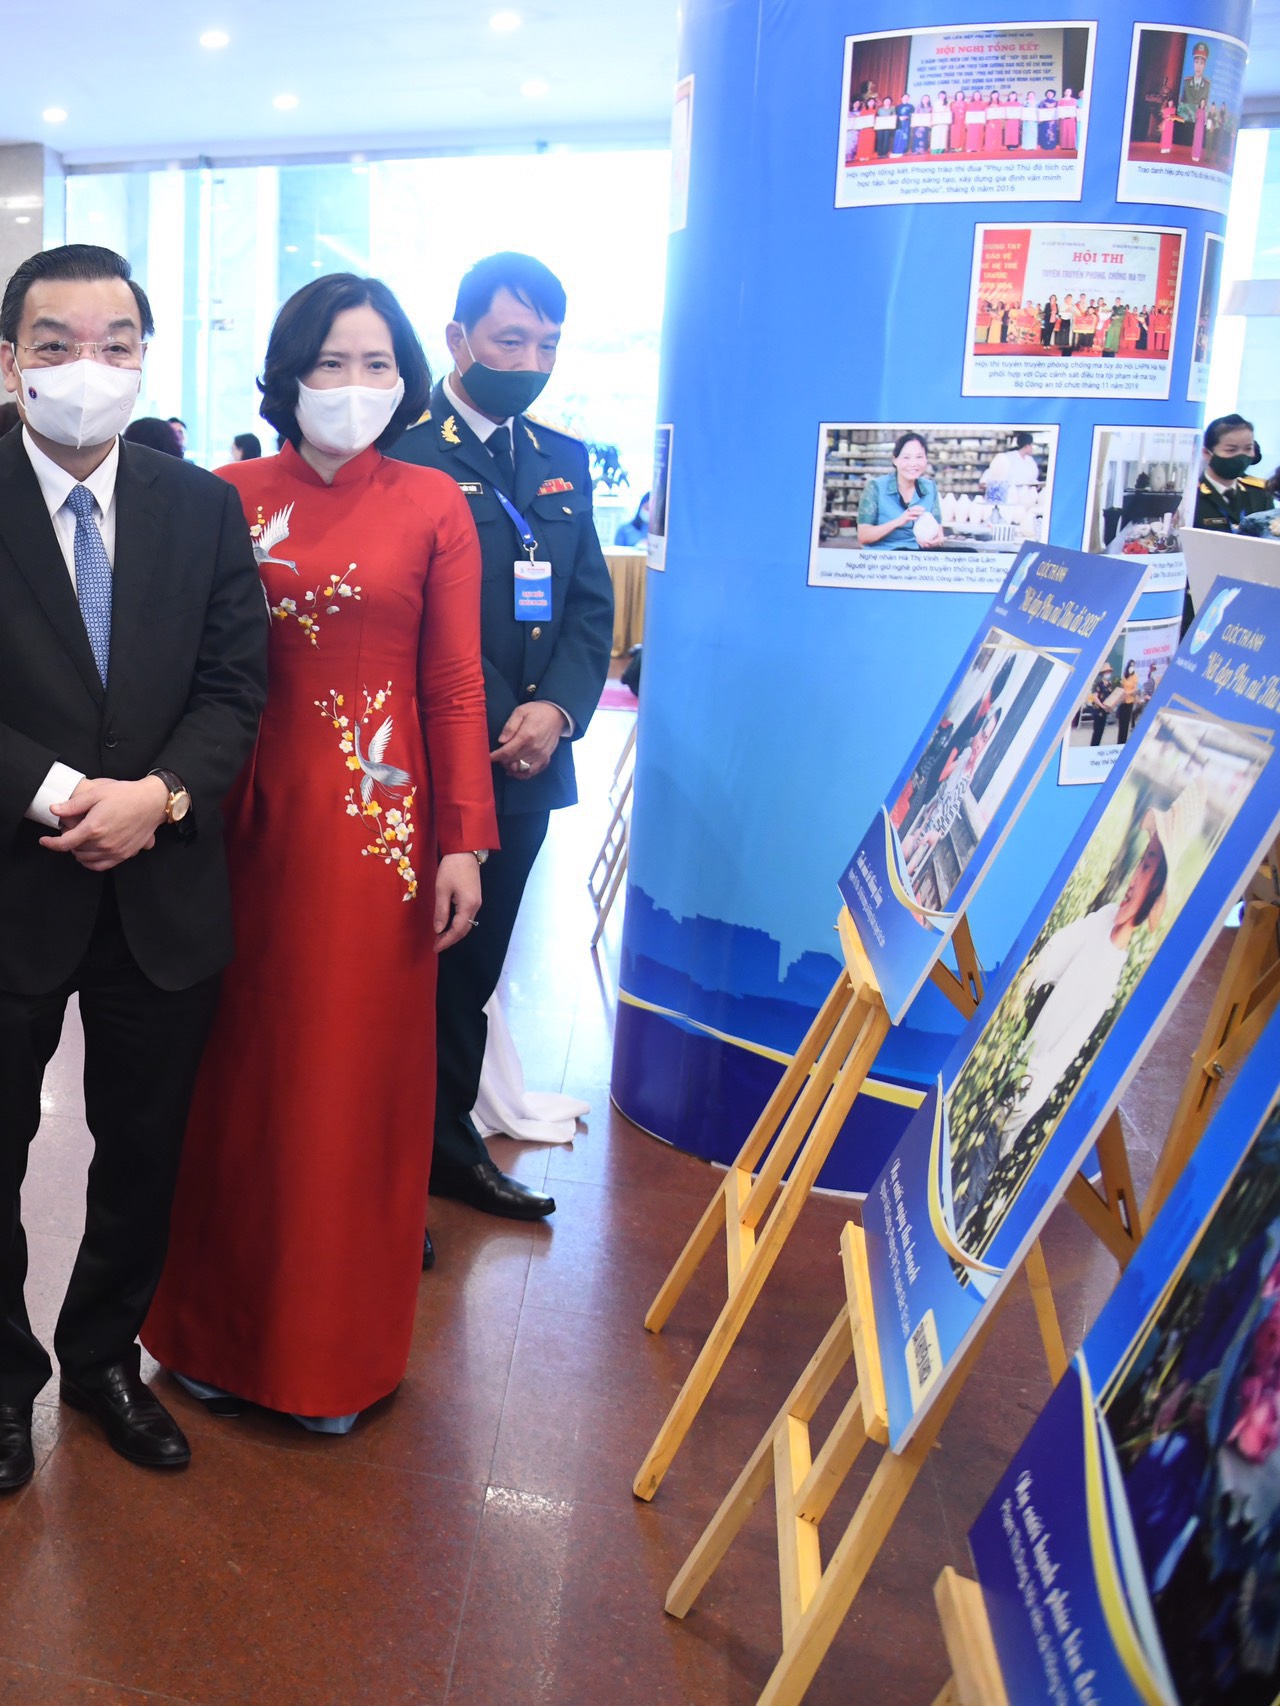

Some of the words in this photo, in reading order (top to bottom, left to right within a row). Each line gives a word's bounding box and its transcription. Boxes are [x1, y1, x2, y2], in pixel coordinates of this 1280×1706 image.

[936, 46, 955, 55] HỘI
[958, 45, 984, 54] NGHỊ
[987, 41, 1016, 52] TỔNG
[1019, 40, 1040, 51] KẾT
[1072, 250, 1098, 264] HỘI
[1102, 253, 1124, 264] THI
